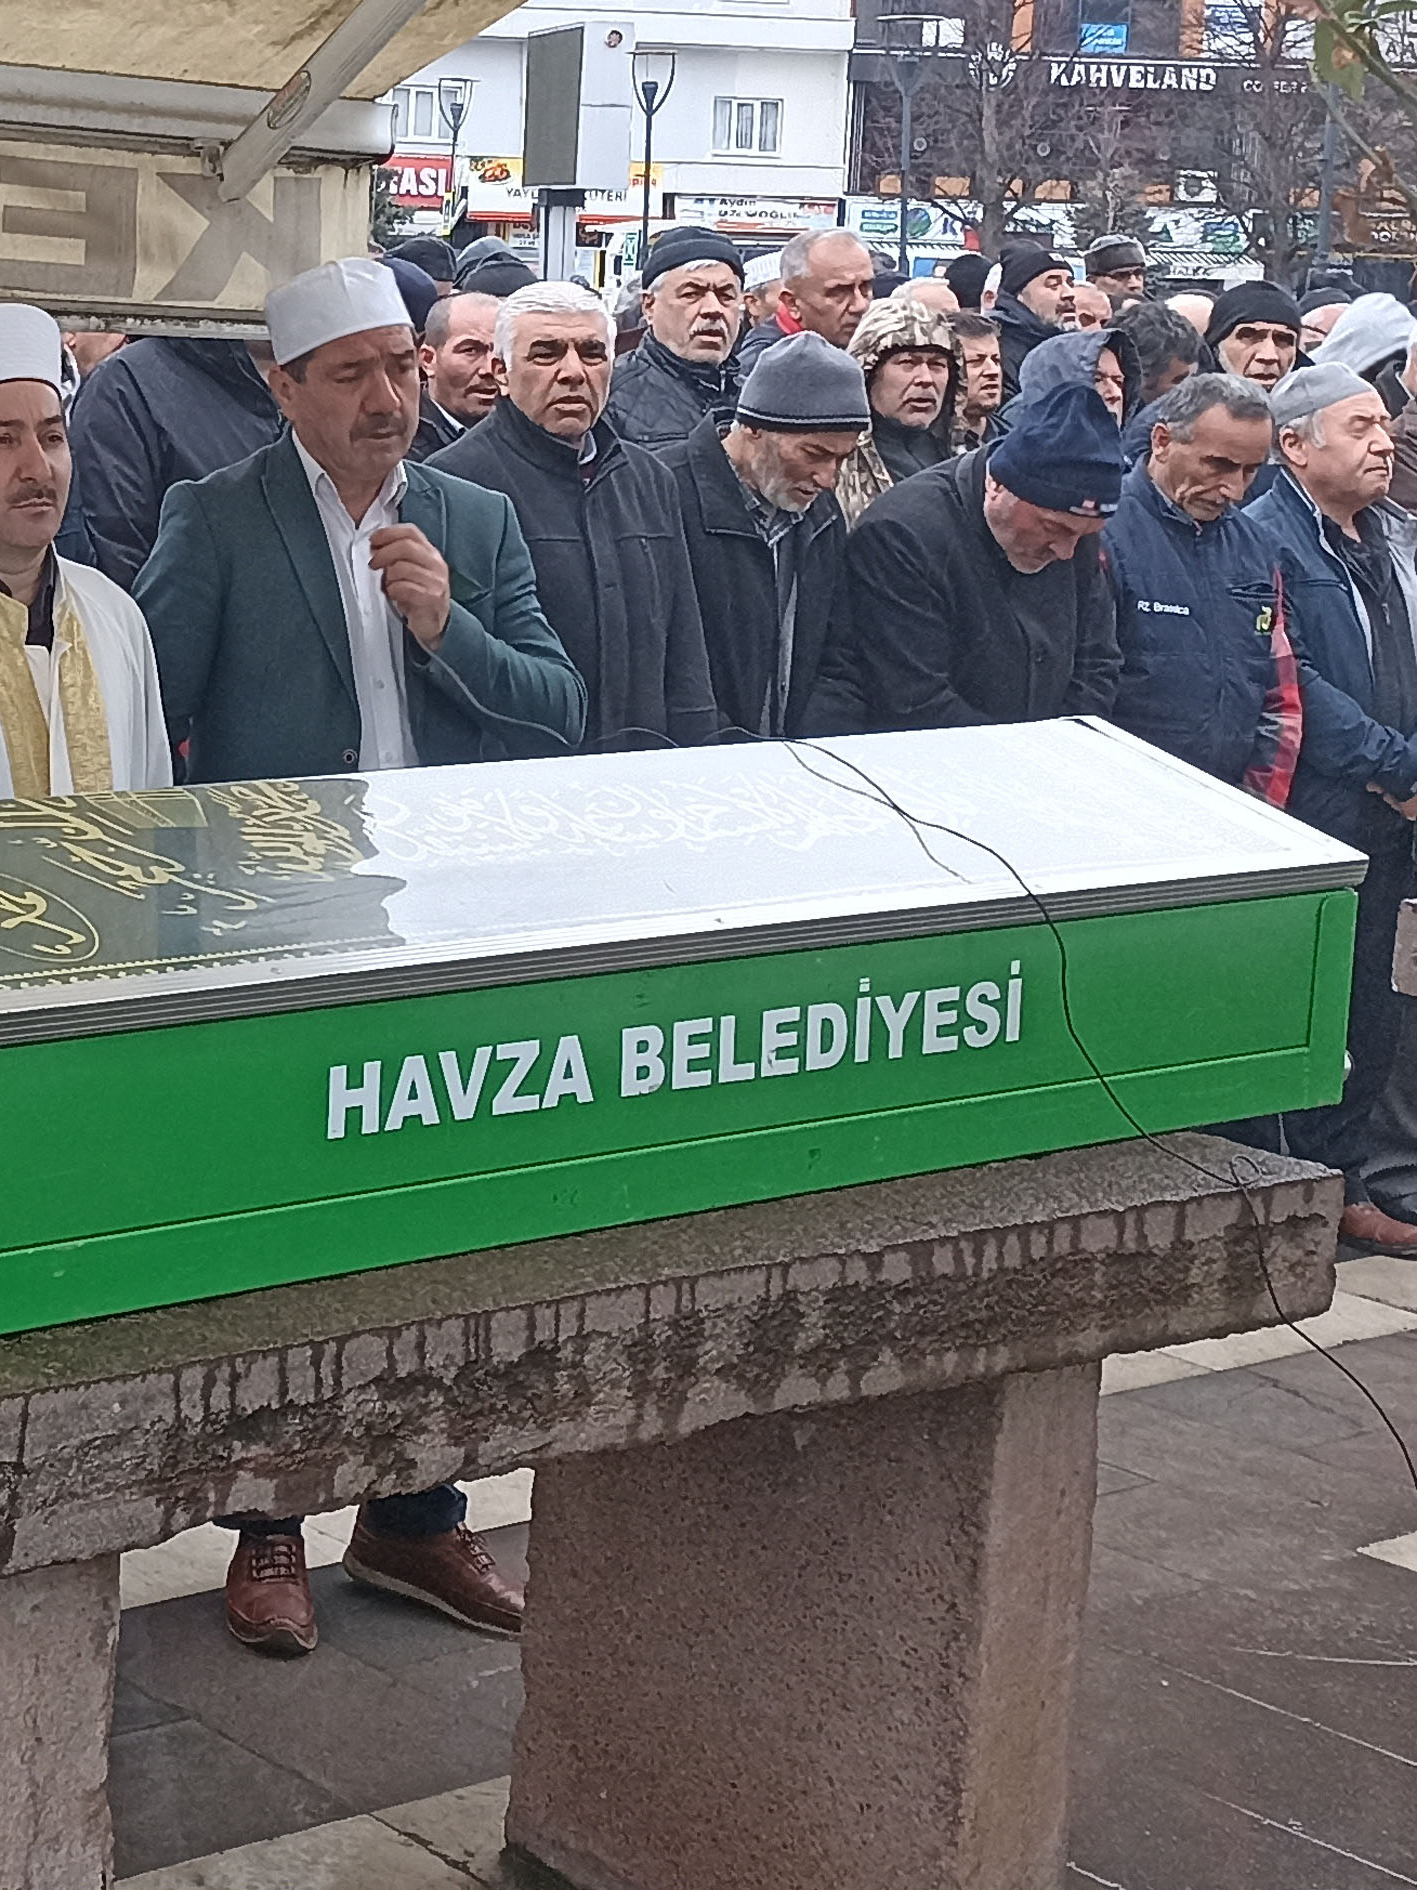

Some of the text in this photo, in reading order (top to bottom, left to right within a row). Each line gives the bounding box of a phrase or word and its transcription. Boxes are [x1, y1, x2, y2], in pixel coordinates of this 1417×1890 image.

[1050, 62, 1217, 91] KAHVELAND
[325, 960, 1025, 1140] HAVZA BELEDİYESİ
